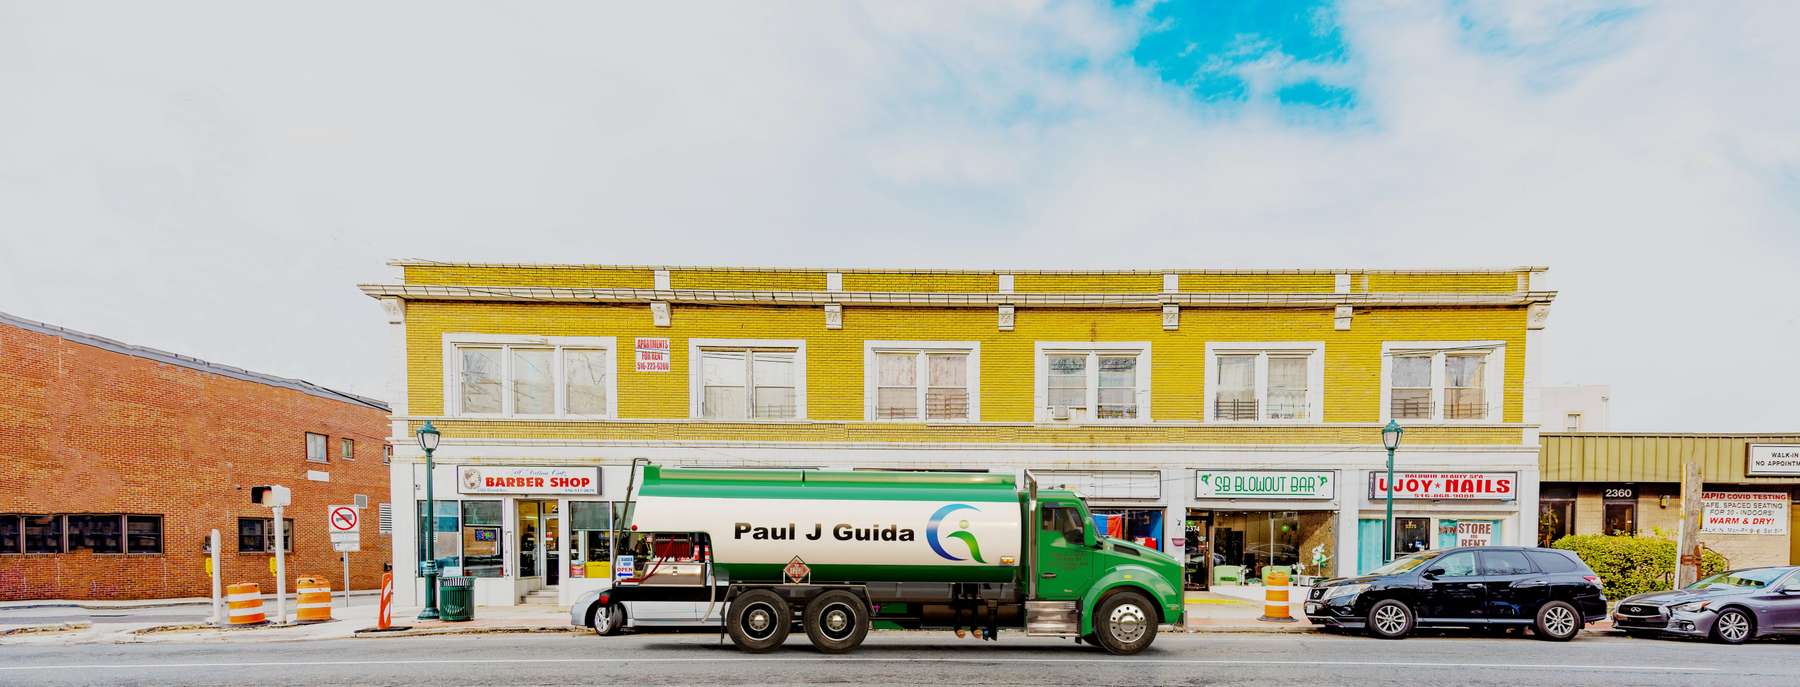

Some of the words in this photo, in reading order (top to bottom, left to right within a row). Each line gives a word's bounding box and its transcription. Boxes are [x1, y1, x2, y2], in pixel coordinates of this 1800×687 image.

[638, 340, 668, 349] APARTMENTS
[642, 352, 650, 360] FOR
[485, 477, 544, 488] BARBER
[550, 477, 590, 488] SHOP
[1215, 476, 1231, 492] SB
[1235, 476, 1287, 492] BLOWOUT
[1290, 476, 1315, 492] BAR
[1445, 479, 1510, 493] NAILS
[1605, 488, 1632, 498] 2360
[734, 522, 796, 541] Paul
[805, 523, 822, 541] J
[832, 523, 915, 542] Guida
[1458, 523, 1491, 534] STORE
[1461, 539, 1487, 547] RENT
